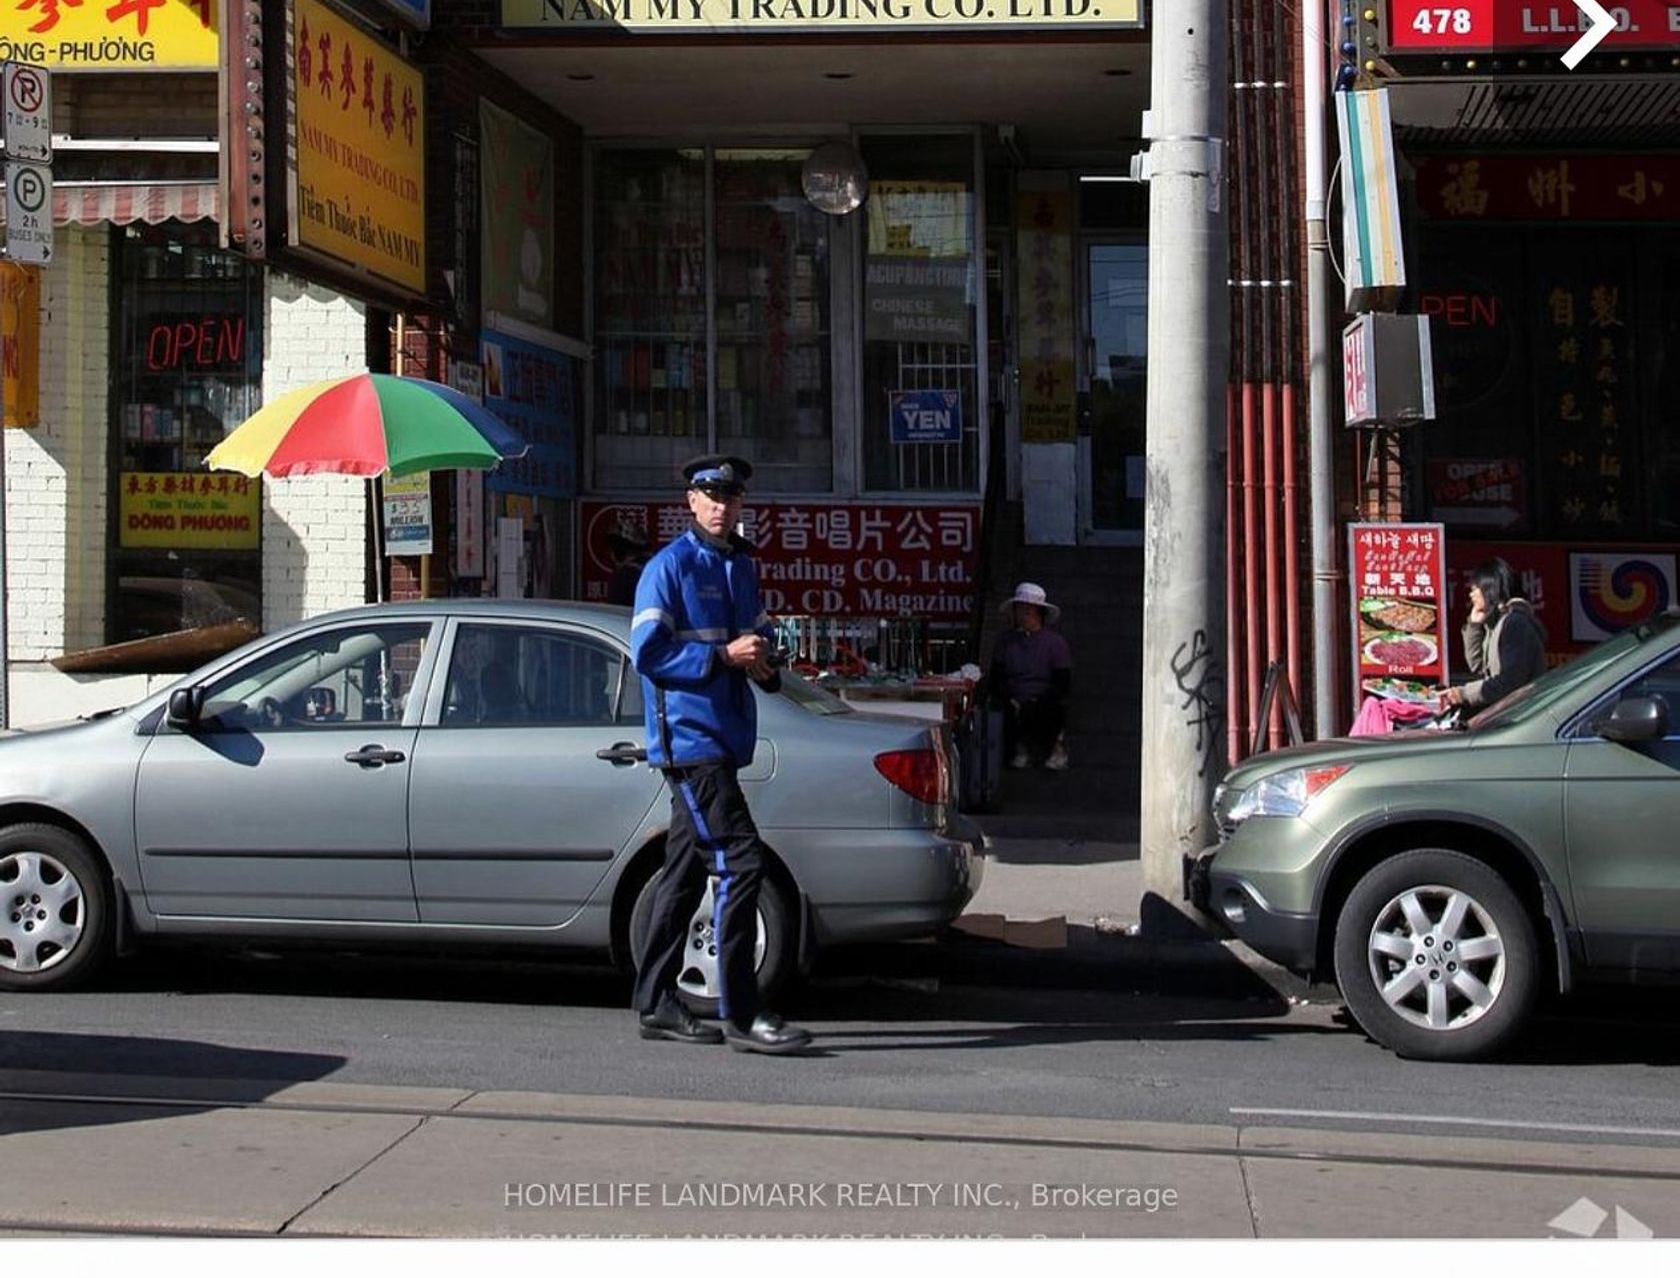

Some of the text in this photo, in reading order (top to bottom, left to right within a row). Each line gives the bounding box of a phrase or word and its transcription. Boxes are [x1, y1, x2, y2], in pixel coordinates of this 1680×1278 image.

[1413, 8, 1471, 34] 478
[148, 319, 244, 372] OPEN
[902, 409, 952, 431] YEN
[920, 558, 973, 583] Ltd.
[860, 587, 974, 617] Magazine
[1388, 665, 1413, 675] Roll
